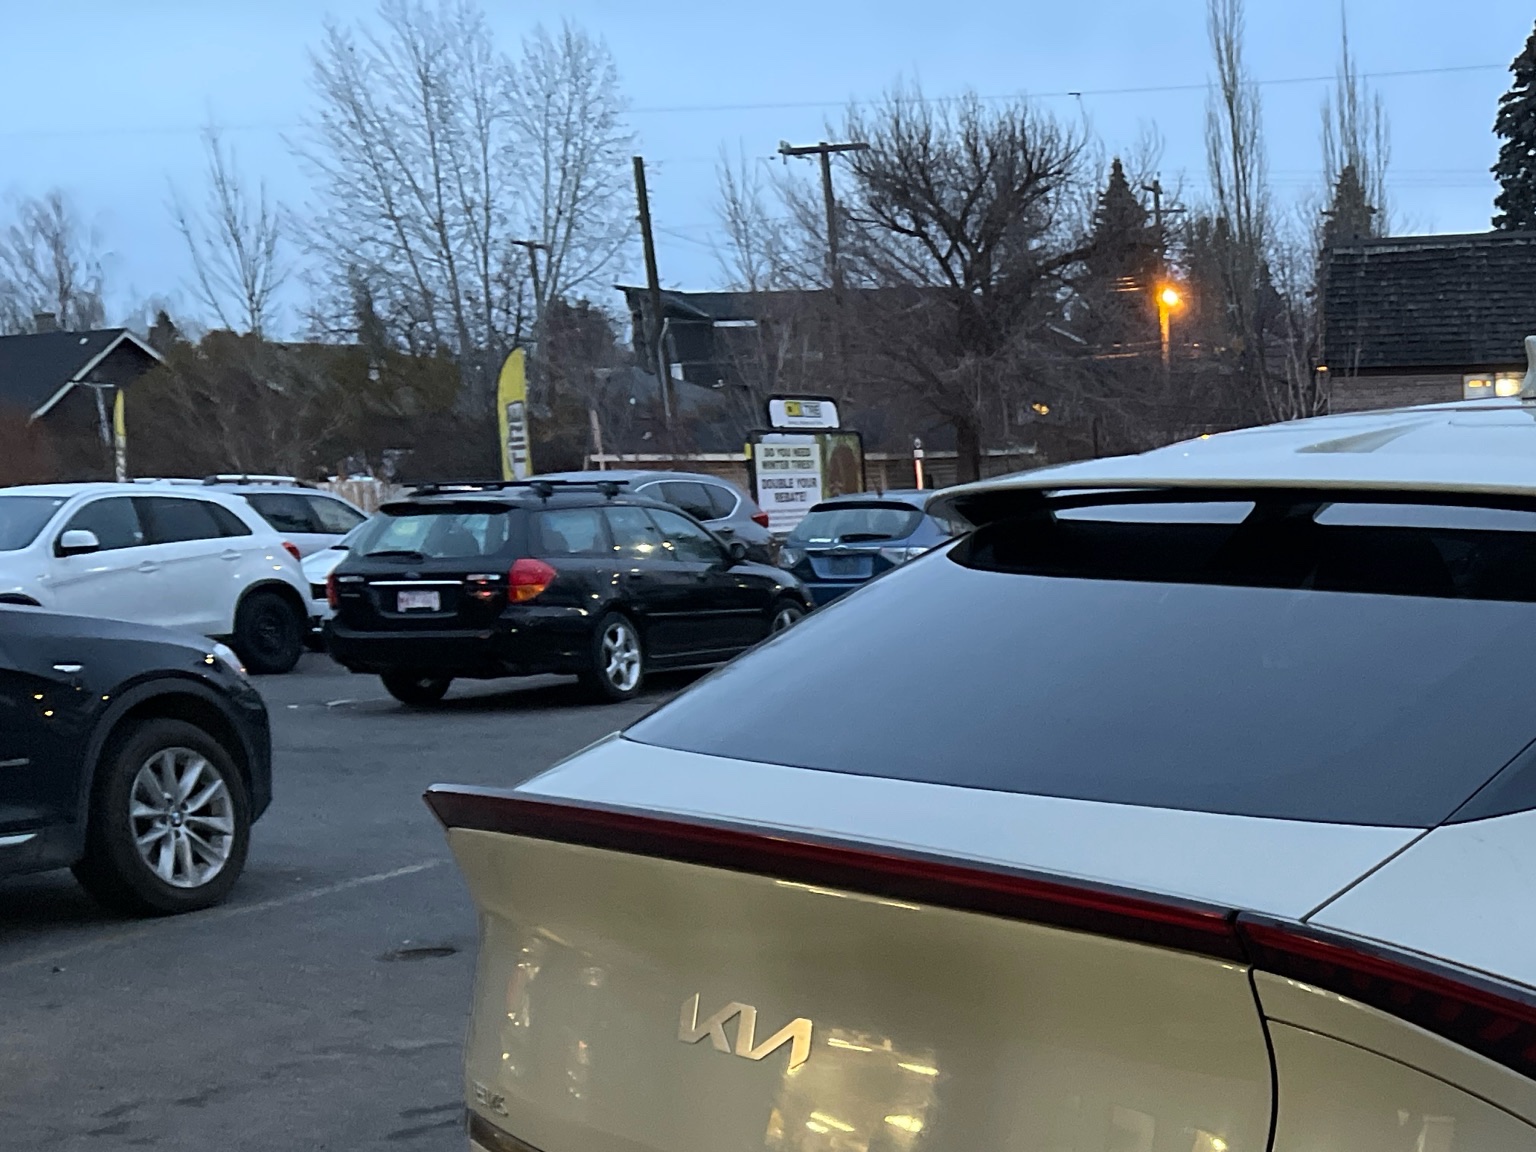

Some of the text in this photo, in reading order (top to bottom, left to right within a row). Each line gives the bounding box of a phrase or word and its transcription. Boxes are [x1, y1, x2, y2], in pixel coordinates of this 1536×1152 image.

[764, 447, 811, 457] DO YOU NEED
[762, 460, 789, 469] WINTER
[762, 478, 817, 489] DOUBLE YOUR
